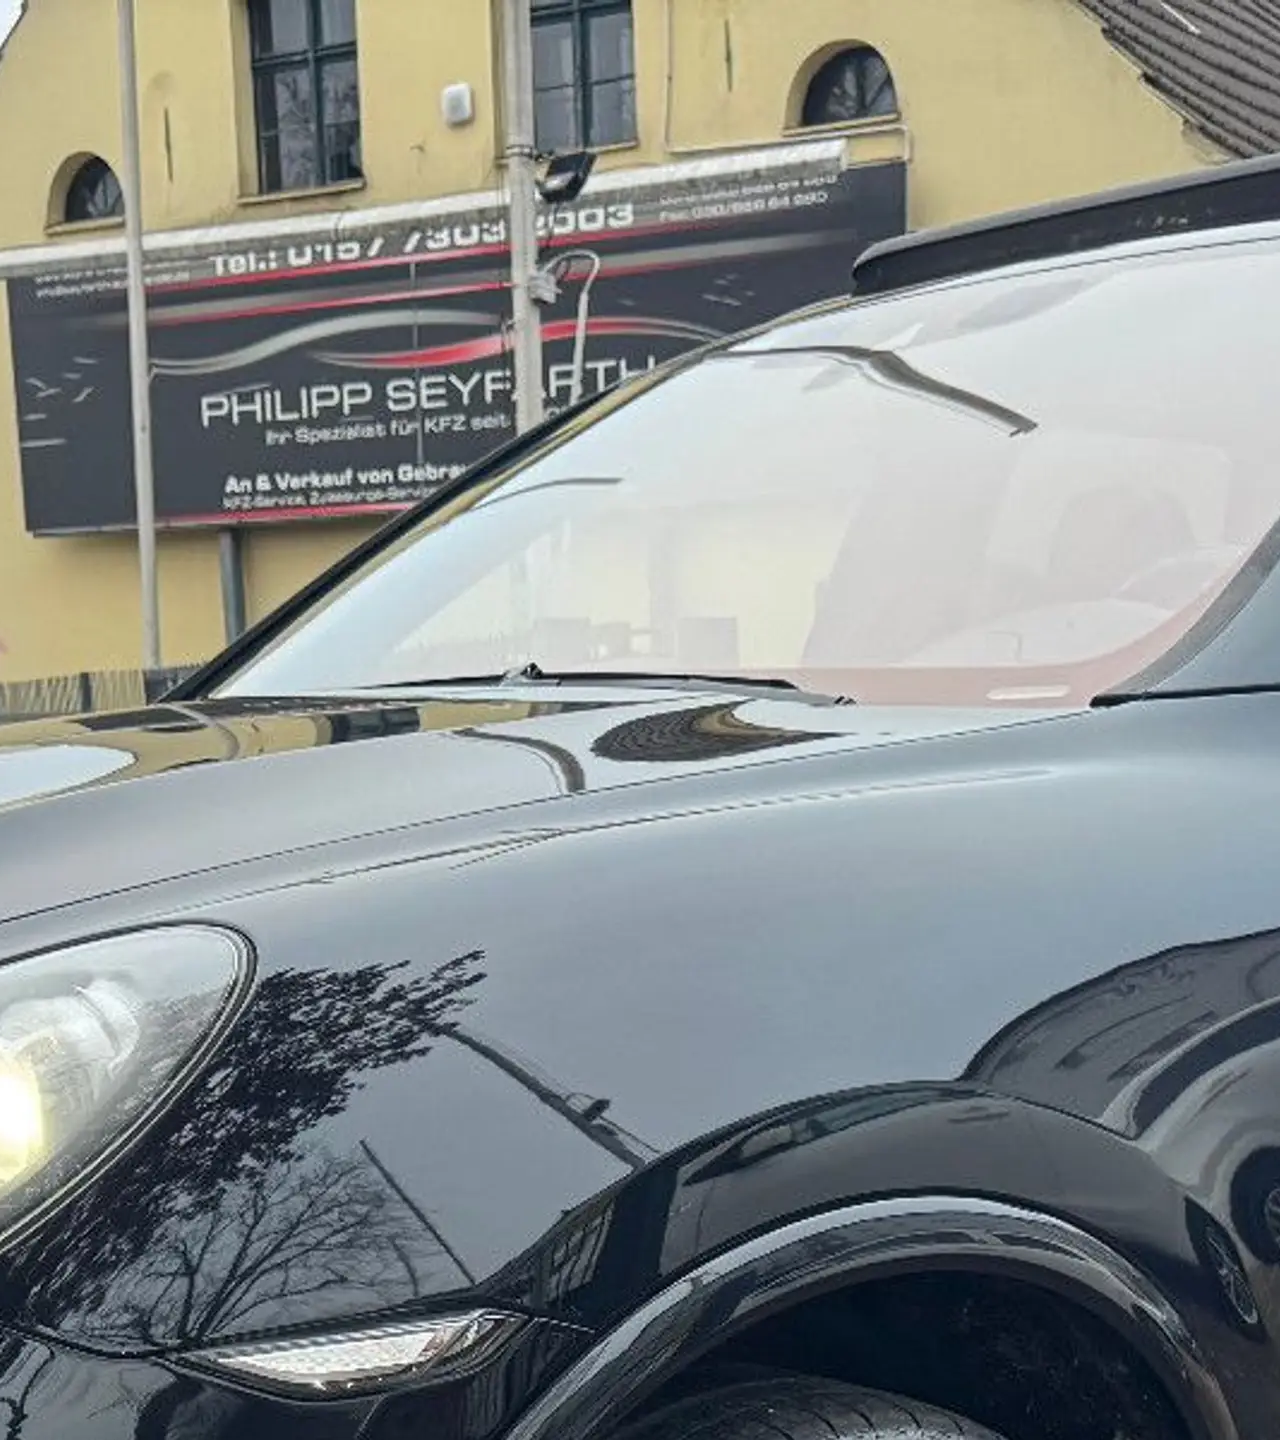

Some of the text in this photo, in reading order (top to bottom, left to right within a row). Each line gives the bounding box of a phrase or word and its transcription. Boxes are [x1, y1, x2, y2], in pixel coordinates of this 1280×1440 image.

[210, 251, 278, 278] Tel.:
[200, 355, 657, 428] PHILIPP SEYFRTH
[265, 413, 511, 446] Ihr Spezialist für KFZ seit
[224, 476, 252, 494] An
[255, 474, 274, 493] &
[276, 468, 354, 491] Verkauf
[357, 470, 394, 487] von
